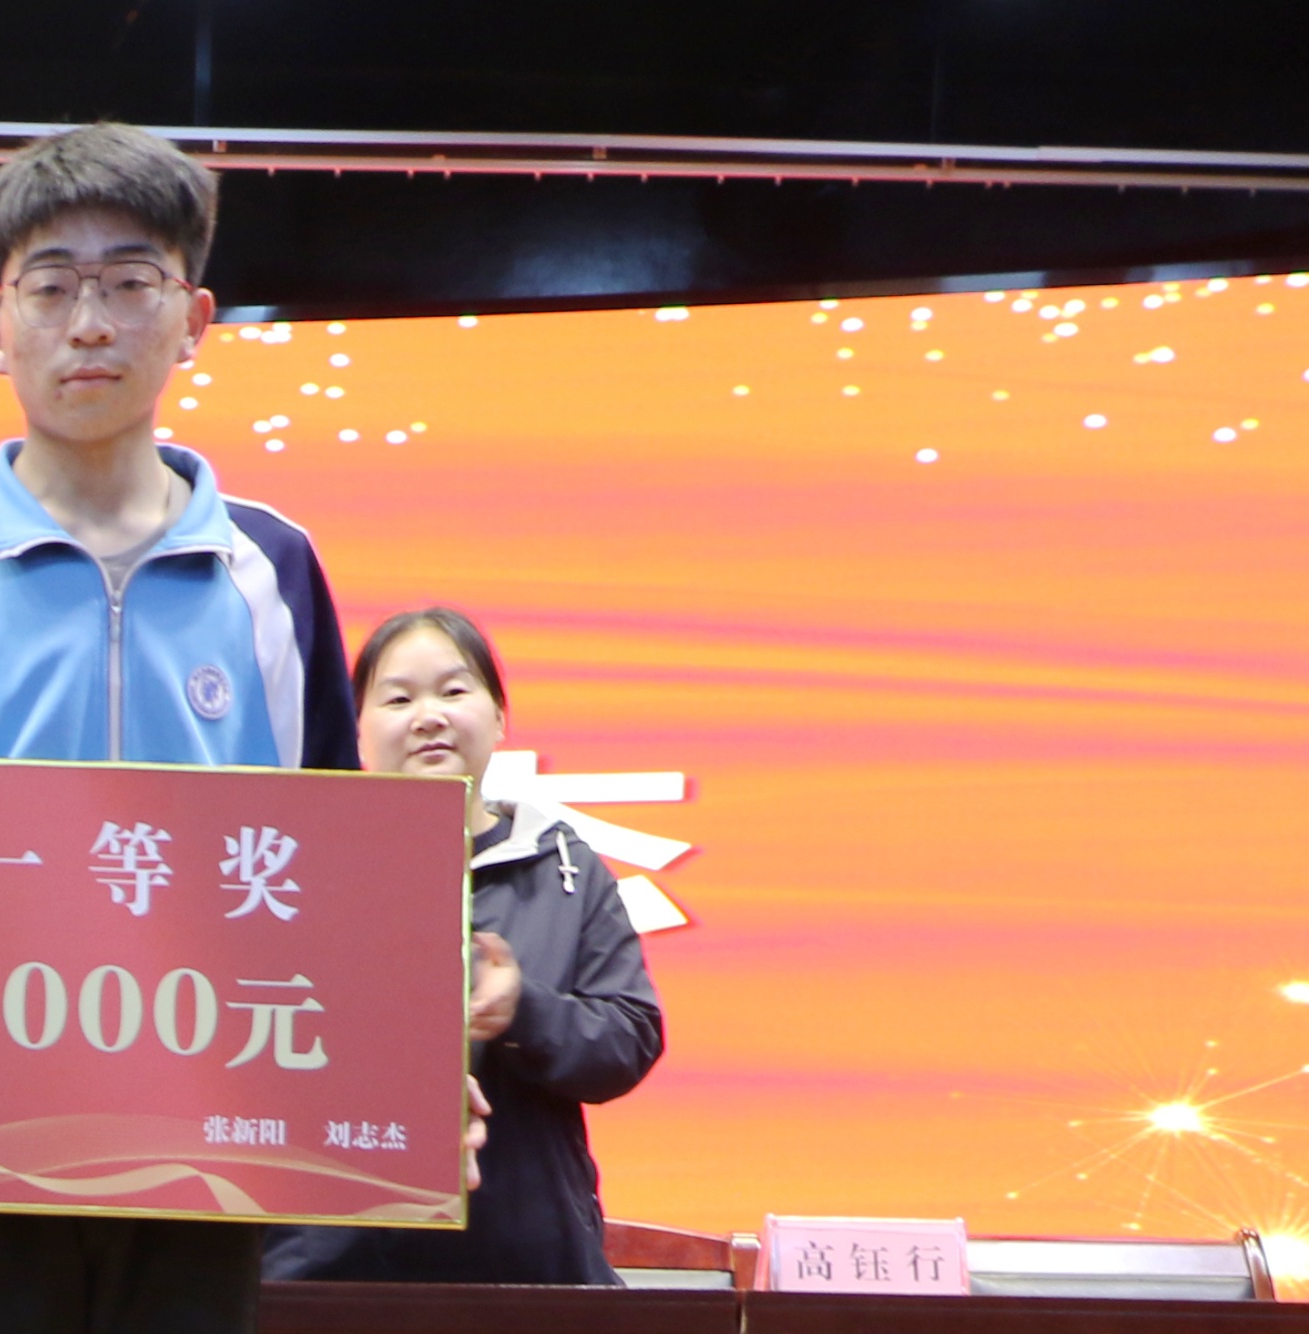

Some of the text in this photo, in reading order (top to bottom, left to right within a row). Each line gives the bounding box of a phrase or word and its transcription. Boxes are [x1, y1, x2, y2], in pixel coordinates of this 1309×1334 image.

[202, 1115, 408, 1151] 张新阳 刘志杰
[795, 1240, 946, 1283] 高钰行
